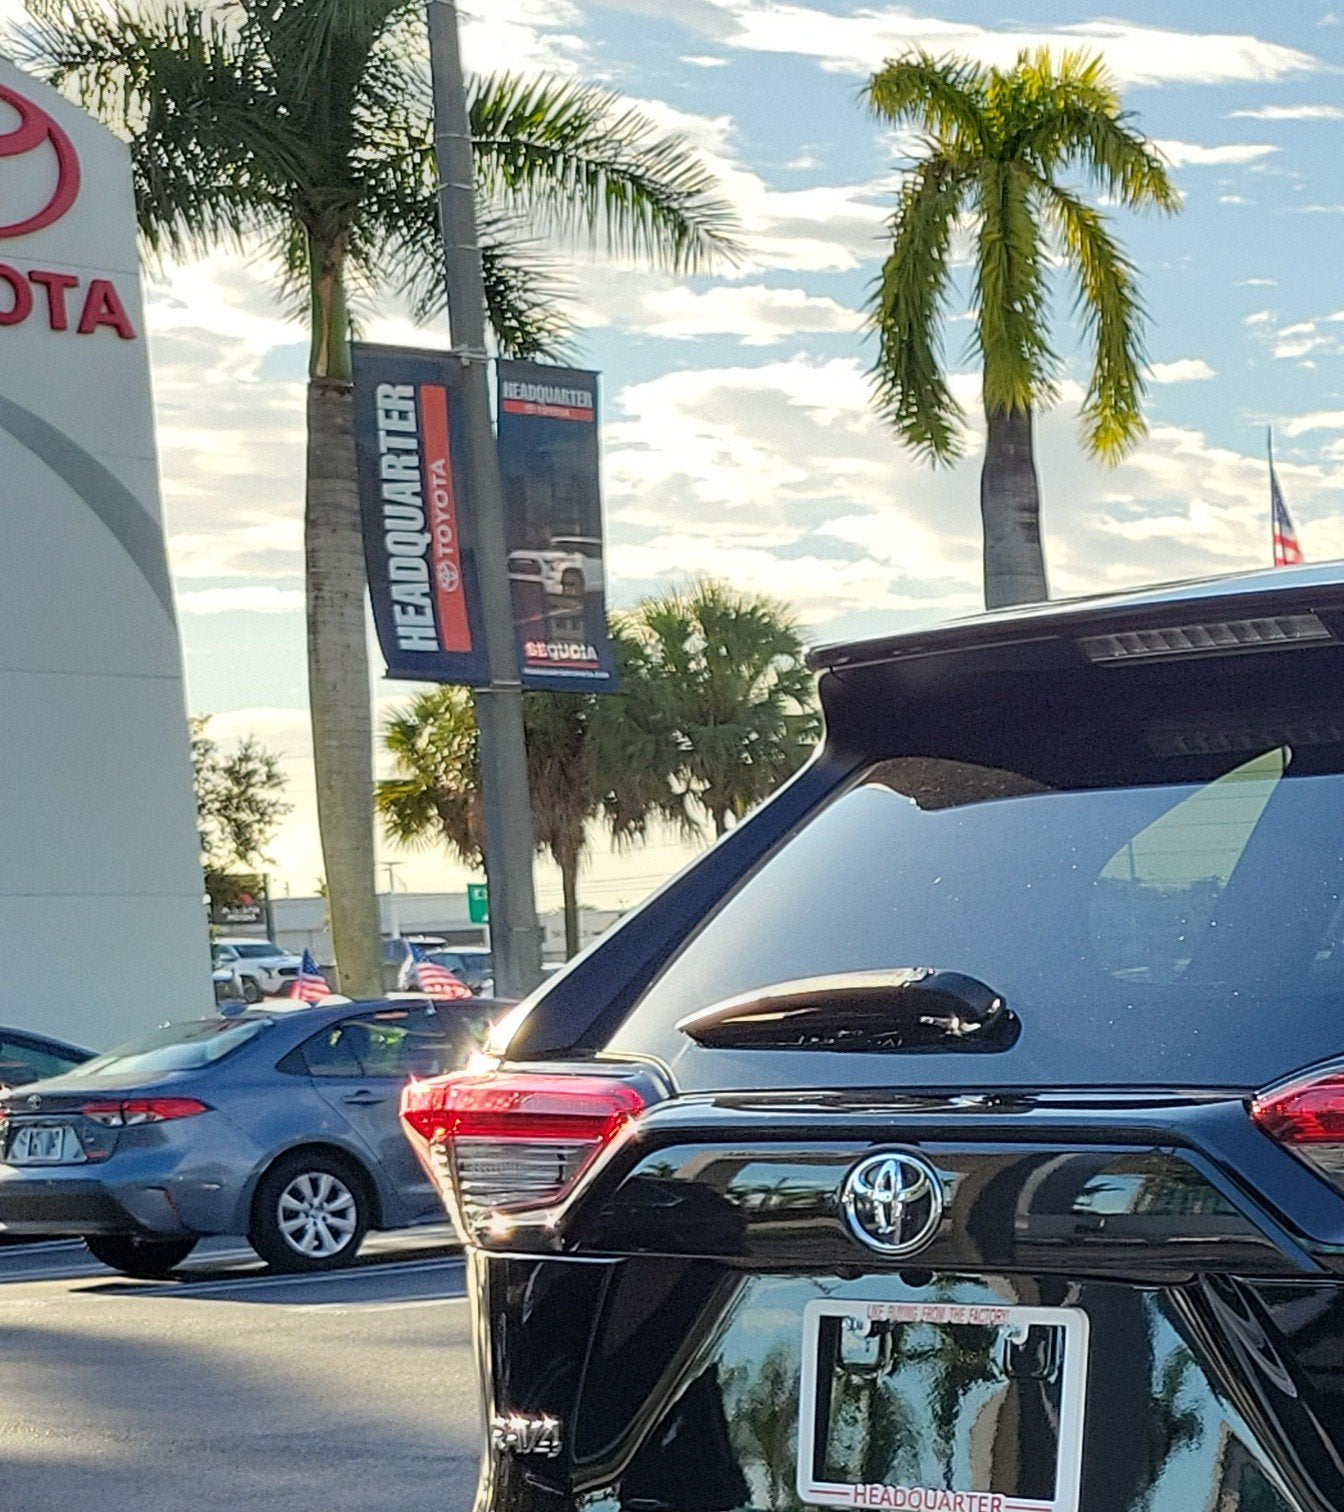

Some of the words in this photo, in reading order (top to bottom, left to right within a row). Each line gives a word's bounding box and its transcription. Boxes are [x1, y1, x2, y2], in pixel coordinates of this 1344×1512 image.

[503, 381, 593, 408] HEADQUARTER
[376, 382, 440, 651] HEADQUARTER
[432, 458, 455, 556] TOYOTA
